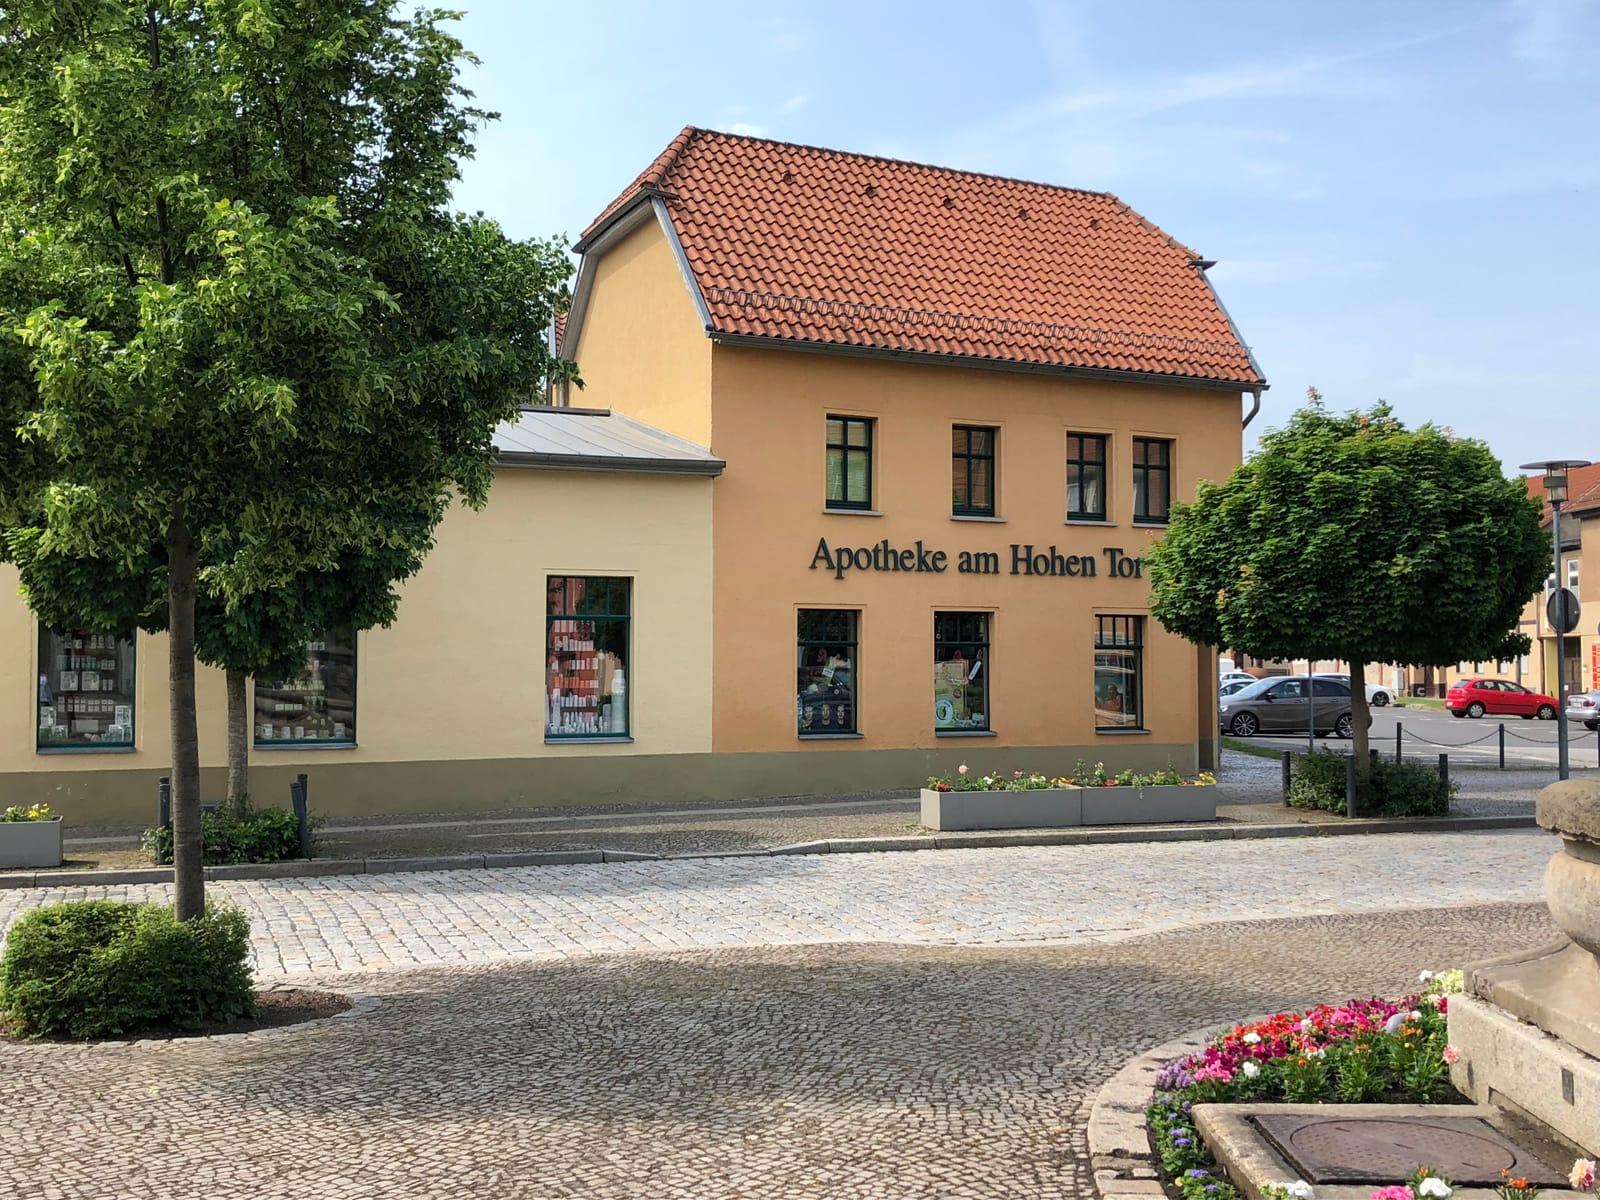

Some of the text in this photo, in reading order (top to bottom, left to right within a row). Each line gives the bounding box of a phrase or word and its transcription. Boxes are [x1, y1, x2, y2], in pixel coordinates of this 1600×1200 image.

[808, 536, 1144, 579] Apotheke am Hohen Tor
